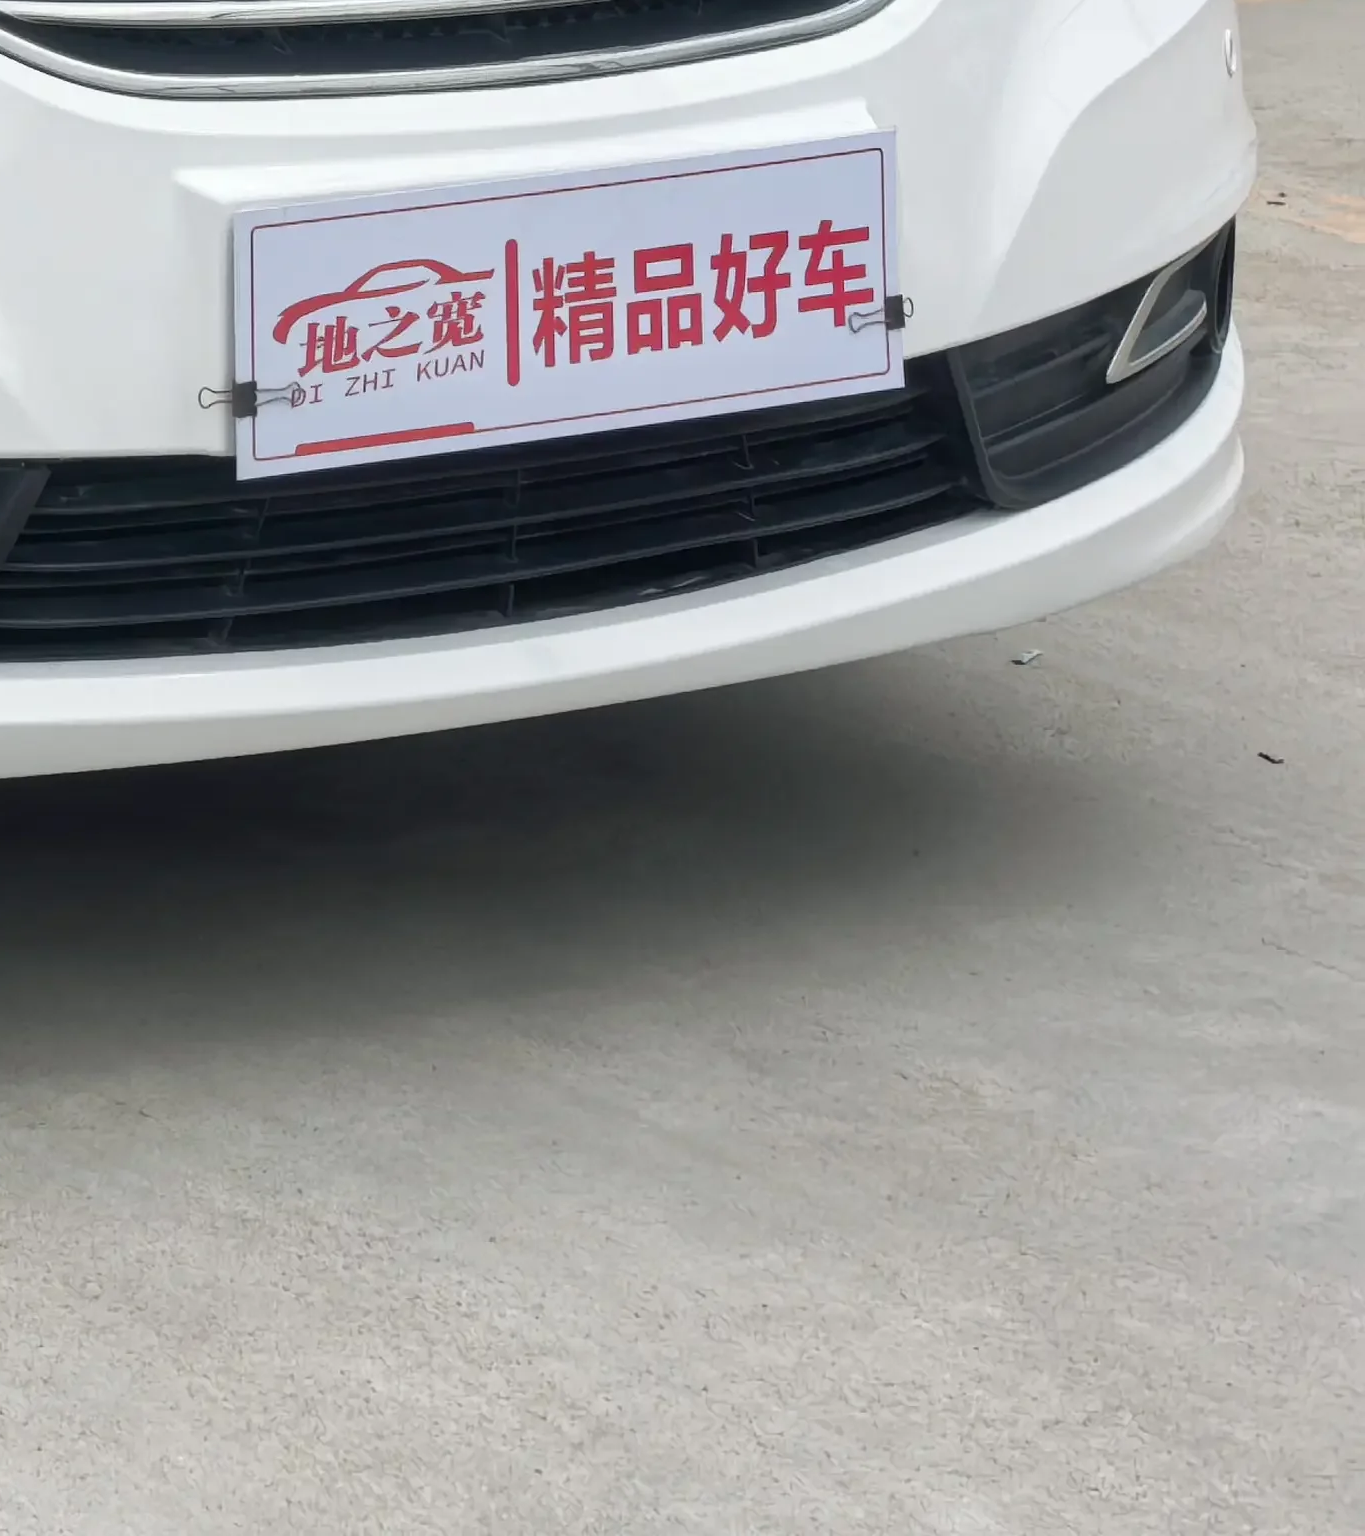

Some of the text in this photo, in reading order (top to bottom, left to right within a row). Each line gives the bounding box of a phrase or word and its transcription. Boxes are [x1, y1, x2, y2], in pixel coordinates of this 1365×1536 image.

[297, 291, 486, 378] 地之宽
[531, 219, 875, 368] 精品好车
[291, 349, 485, 409] DI ZHI KUAN
